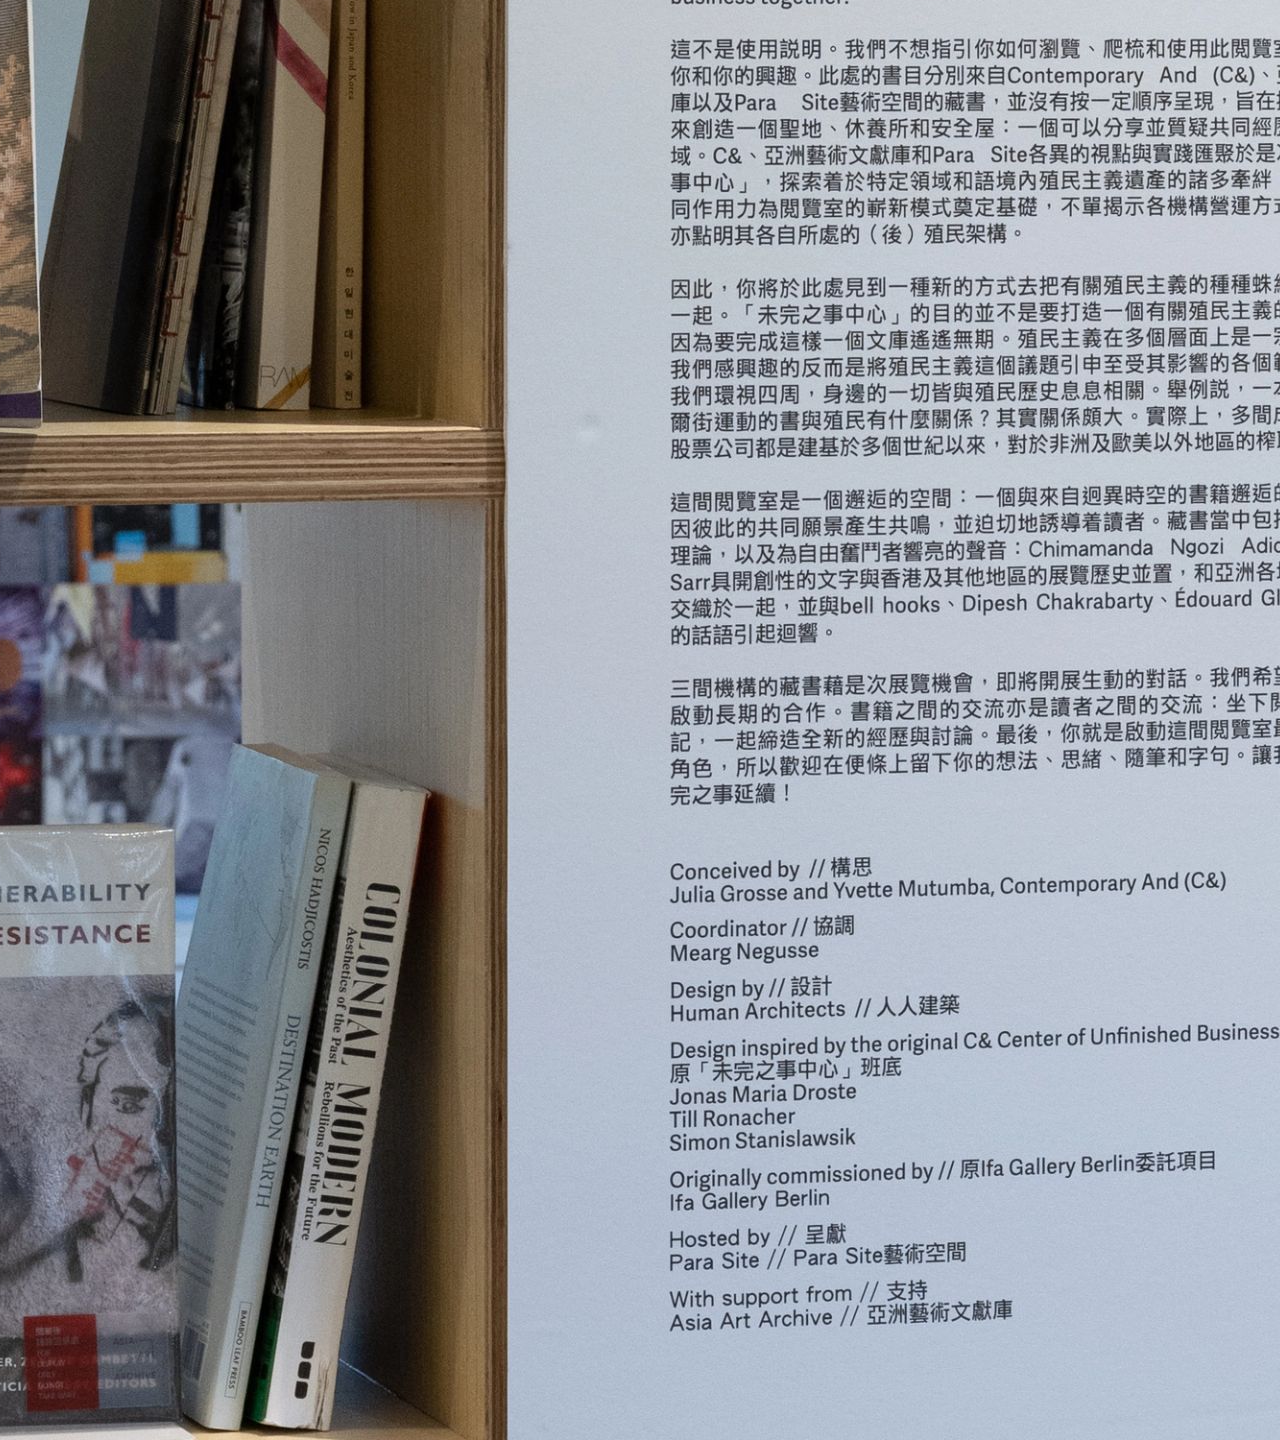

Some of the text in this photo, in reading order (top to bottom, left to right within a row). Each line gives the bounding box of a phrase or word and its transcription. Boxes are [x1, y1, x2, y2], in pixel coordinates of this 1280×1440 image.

[671, 223, 1020, 246] 亦點明其各自所處的（後）殖民架構。
[672, 623, 832, 645] 的話語引起迴響。
[670, 783, 788, 805] 完之事延續！
[671, 942, 818, 964] Mearg Negusse
[316, 883, 400, 1245] COLONIAL MODERN
[256, 1015, 300, 1207] DESTINATION EARTH
